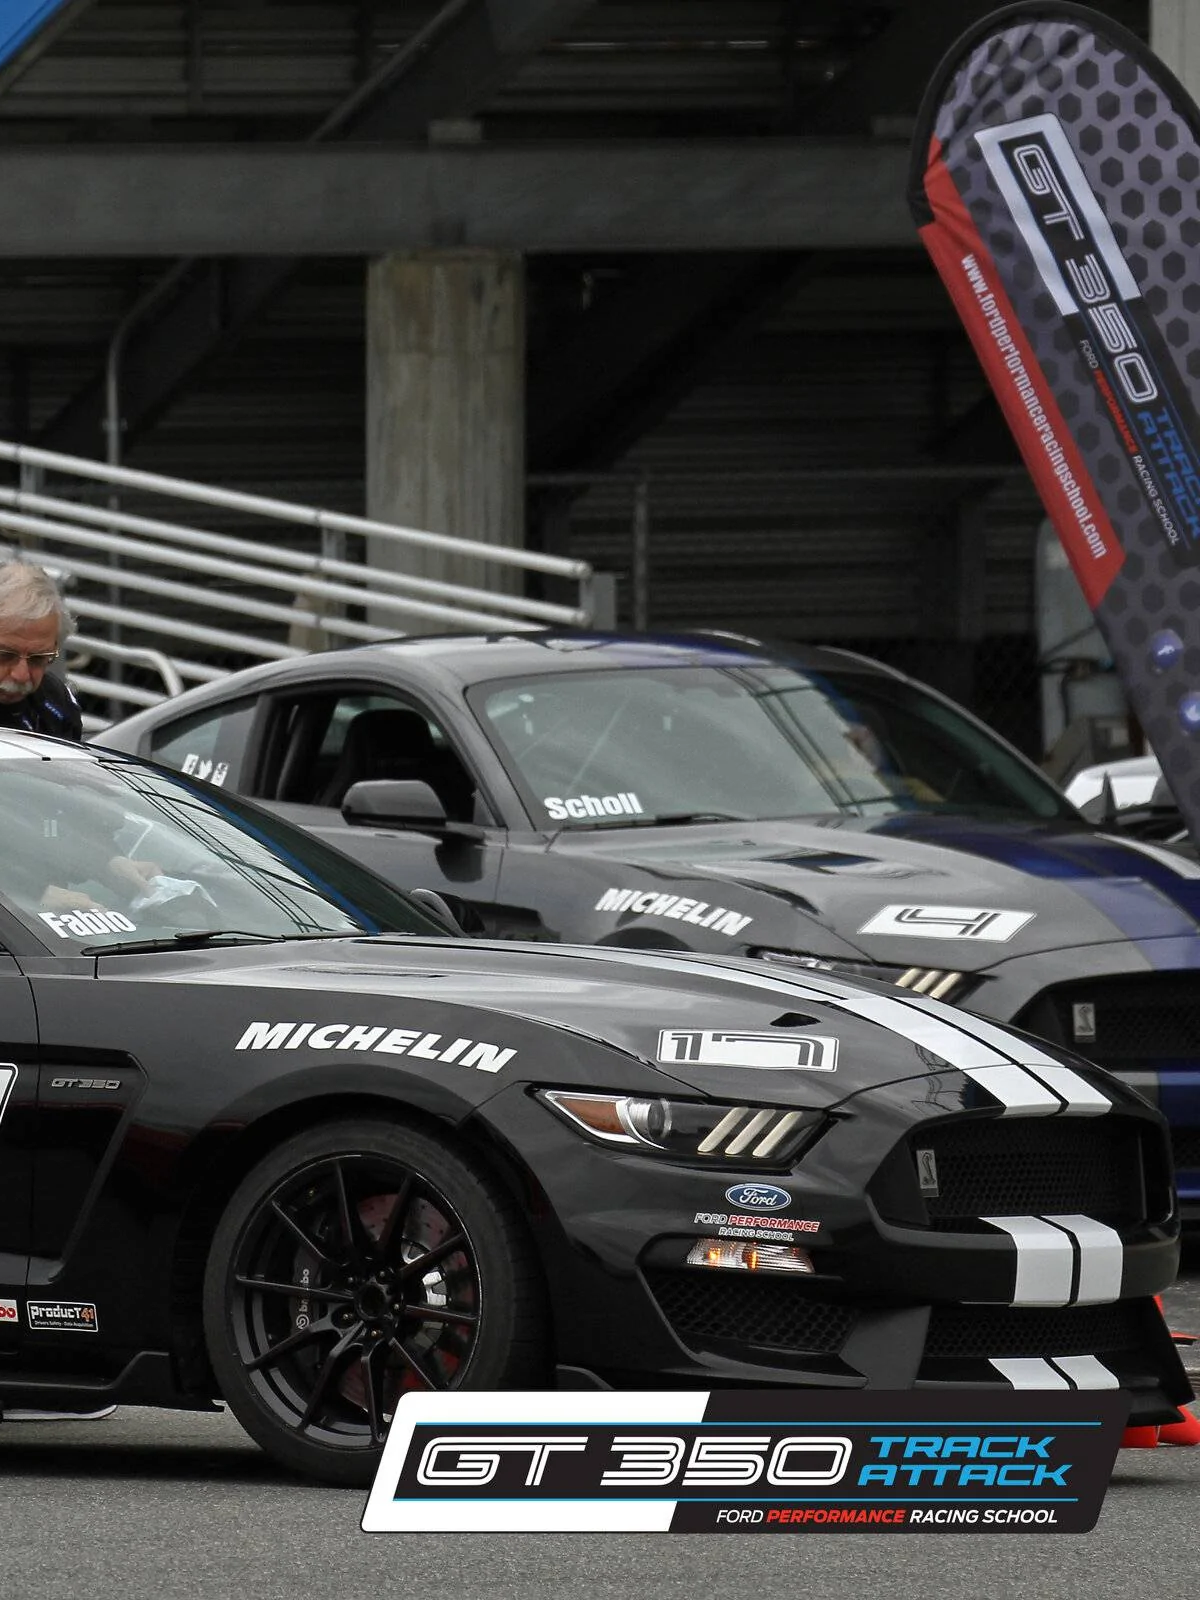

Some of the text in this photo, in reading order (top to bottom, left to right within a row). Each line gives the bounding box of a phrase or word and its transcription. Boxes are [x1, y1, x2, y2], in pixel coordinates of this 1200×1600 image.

[1013, 143, 1158, 404] GT 350
[961, 254, 1107, 559] www.fordperformanceracingschool.com
[1132, 455, 1158, 498] RACING
[1153, 498, 1180, 545] SCHOOL
[544, 792, 643, 821] Scholl
[38, 908, 137, 939] Fabio
[595, 887, 753, 937] MICHELIN
[234, 1022, 517, 1074] MICHELIN
[739, 1188, 778, 1206] Ford
[694, 1212, 820, 1233] FORD PERFORMANCE
[719, 1227, 794, 1241] RACING SCHOOL
